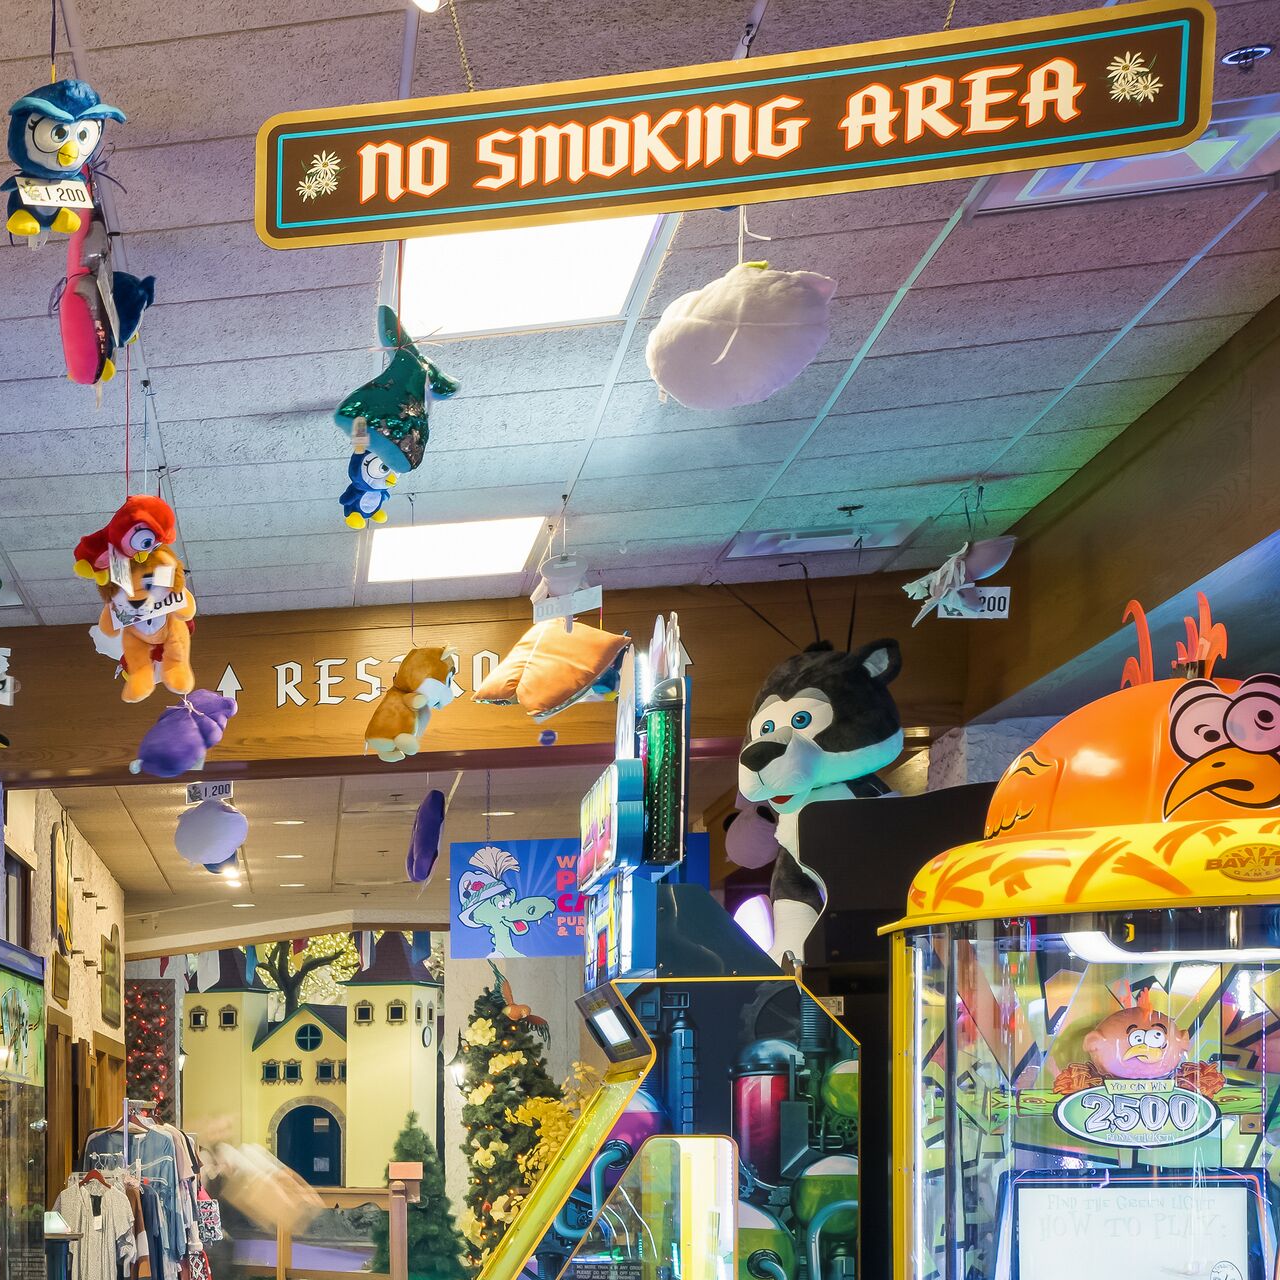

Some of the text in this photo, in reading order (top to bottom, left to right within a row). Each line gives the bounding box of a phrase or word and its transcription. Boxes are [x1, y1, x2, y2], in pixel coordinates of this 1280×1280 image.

[358, 56, 1085, 203] NO SMOKING AREA
[45, 187, 86, 203] 1,200
[202, 783, 232, 798] 1,200
[1205, 857, 1251, 871] BAY
